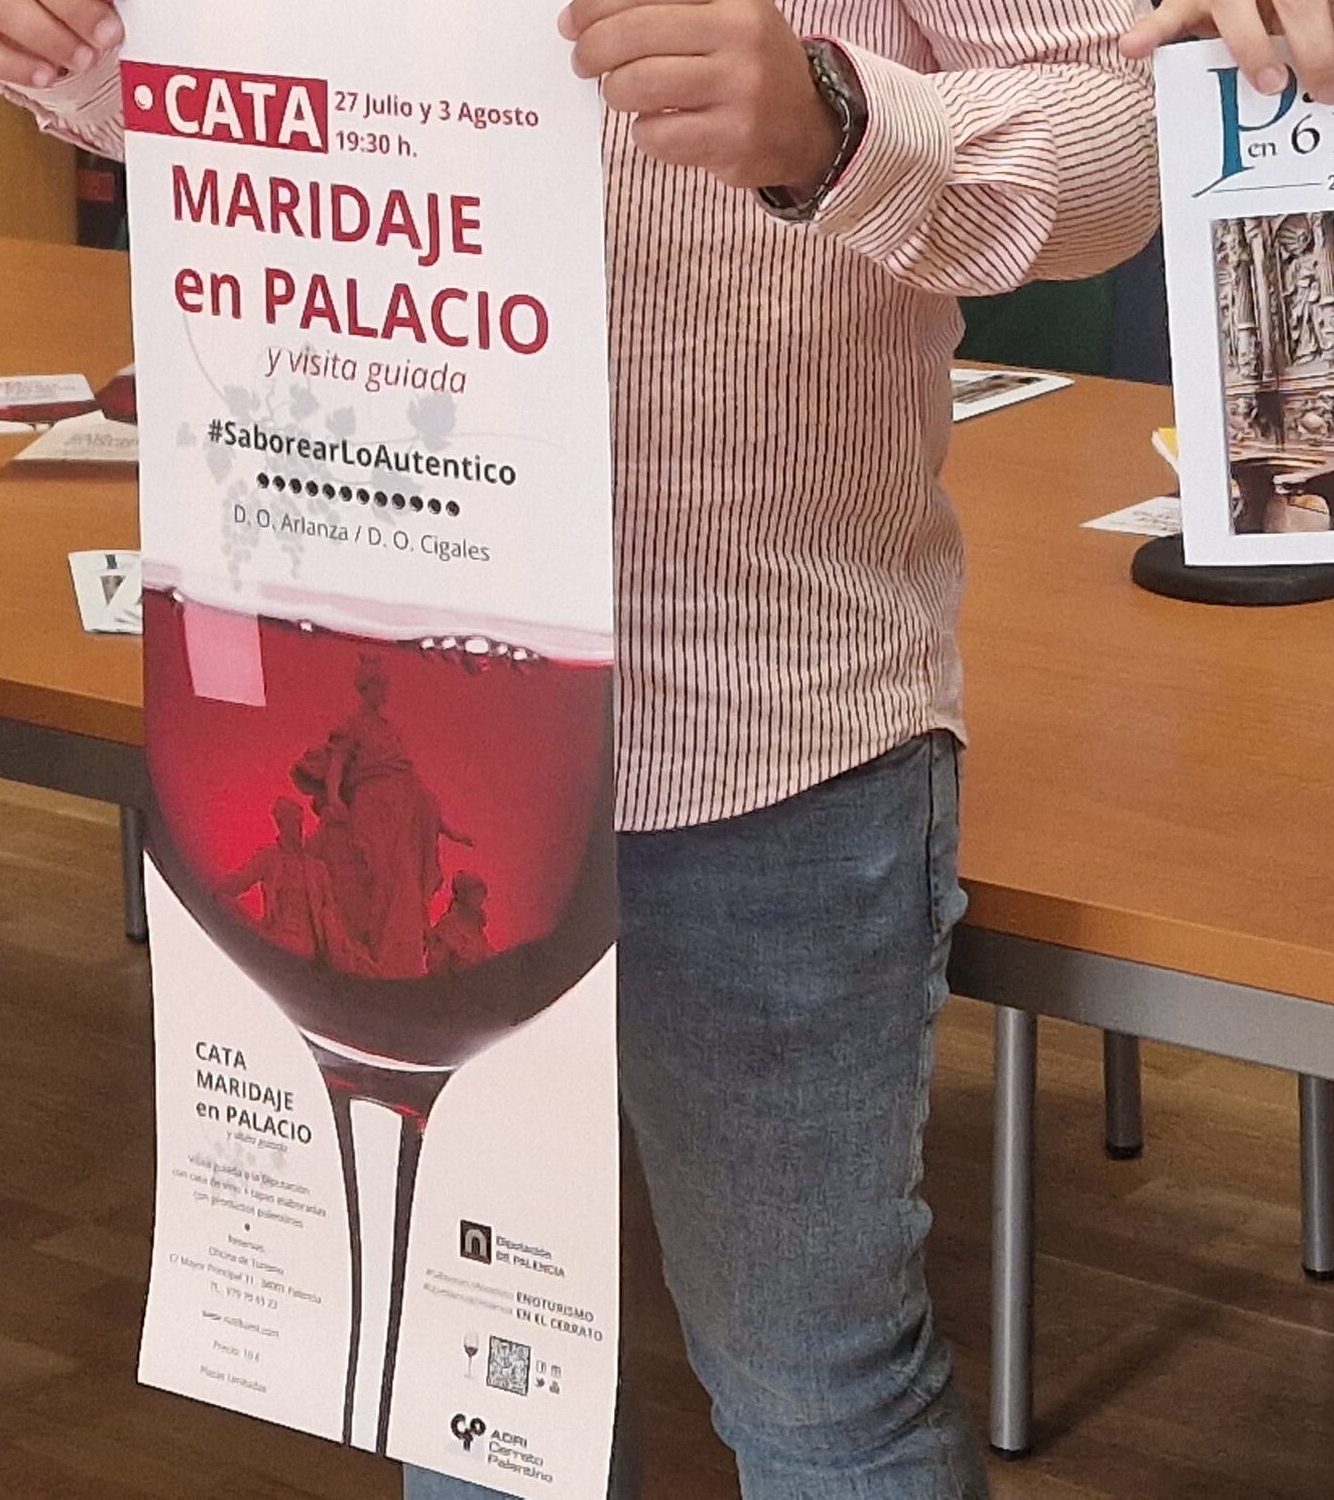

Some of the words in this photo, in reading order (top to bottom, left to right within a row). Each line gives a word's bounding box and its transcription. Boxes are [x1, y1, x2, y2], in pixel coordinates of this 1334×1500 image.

[166, 73, 323, 148] CATA
[334, 91, 359, 112] 27
[362, 96, 413, 119] Julio
[419, 102, 432, 125] y
[438, 101, 451, 121] 3
[457, 101, 539, 130] Agosto
[335, 131, 390, 155] 19:30
[397, 133, 418, 157] h.
[1248, 140, 1277, 157] en
[1291, 113, 1320, 154] 6
[172, 164, 483, 267] MARIDAJE
[174, 266, 241, 320] en
[264, 267, 549, 355] PALACIO
[265, 347, 285, 379] y
[288, 347, 357, 381] visita
[364, 359, 468, 394] guiada
[208, 418, 517, 487] #SaborearLoAutentico
[234, 505, 252, 527] D.
[256, 509, 276, 531] O.
[281, 514, 348, 542] Arlanza
[369, 527, 387, 549] D.
[393, 530, 414, 554] O.
[421, 535, 491, 562] Cigales
[195, 1041, 247, 1071] CATA
[196, 1069, 294, 1113] MARIDAJE
[196, 1101, 219, 1121] en
[226, 1105, 312, 1144] PALACIO
